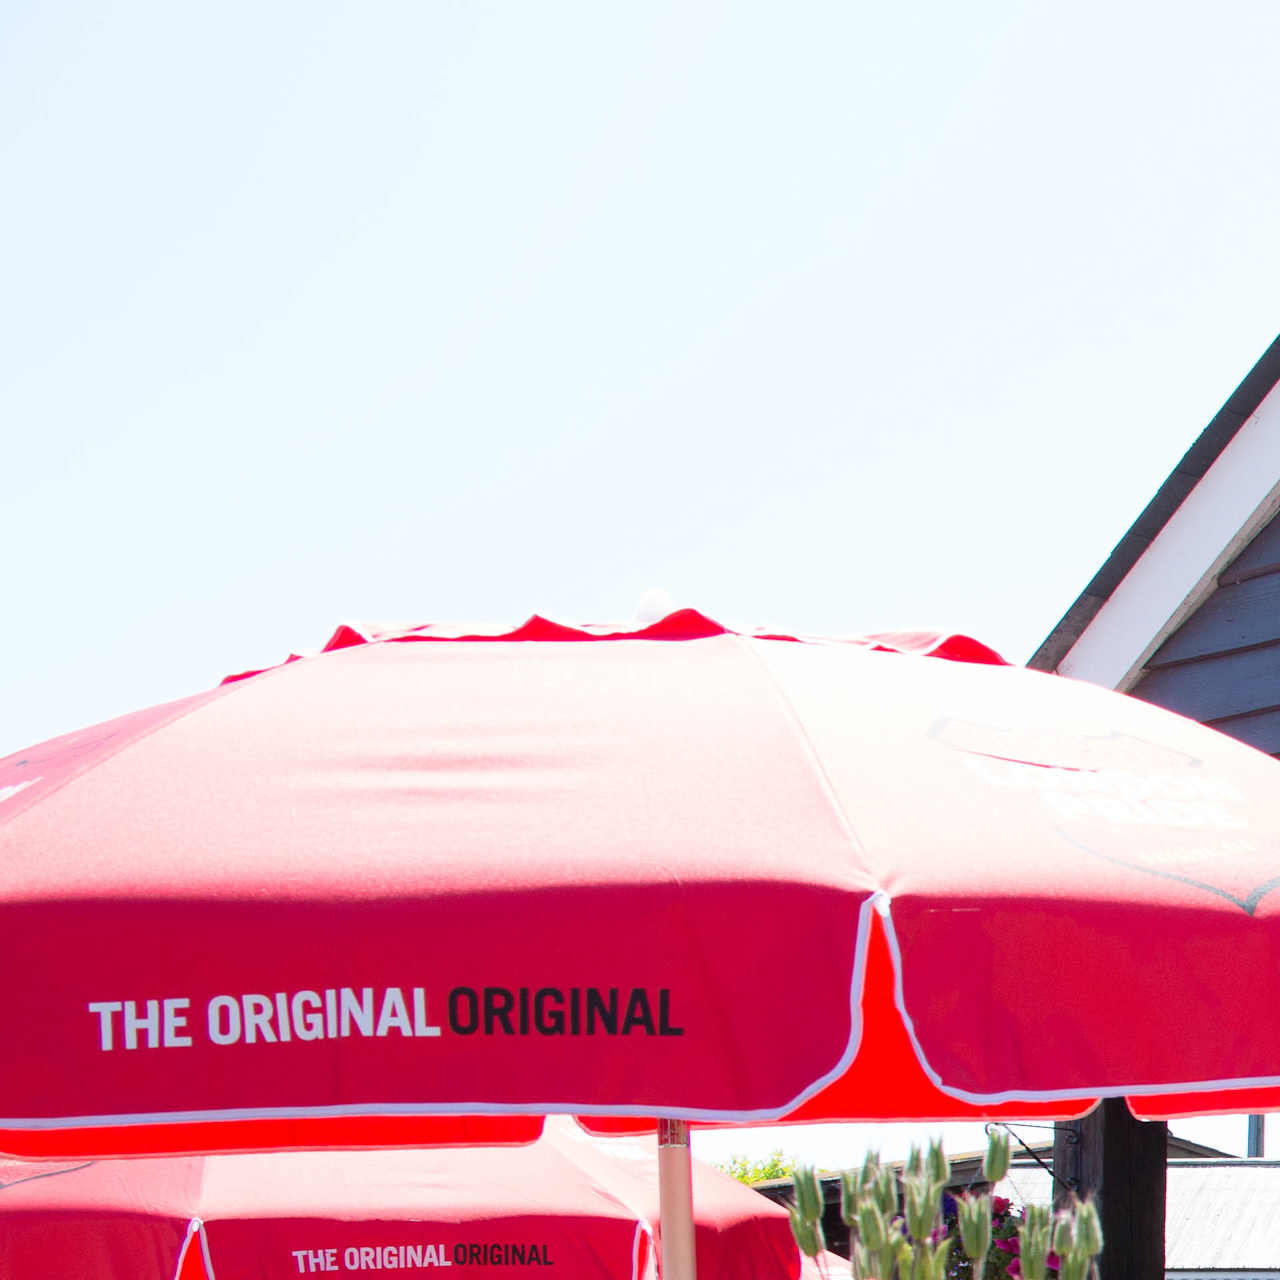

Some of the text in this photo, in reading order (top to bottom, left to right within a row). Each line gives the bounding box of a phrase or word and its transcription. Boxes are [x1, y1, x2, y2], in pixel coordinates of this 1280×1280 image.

[88, 986, 684, 1051] THE ORIGINAL ORIGINAL
[292, 1243, 554, 1274] THE ORIGINAL ORIGINAL
